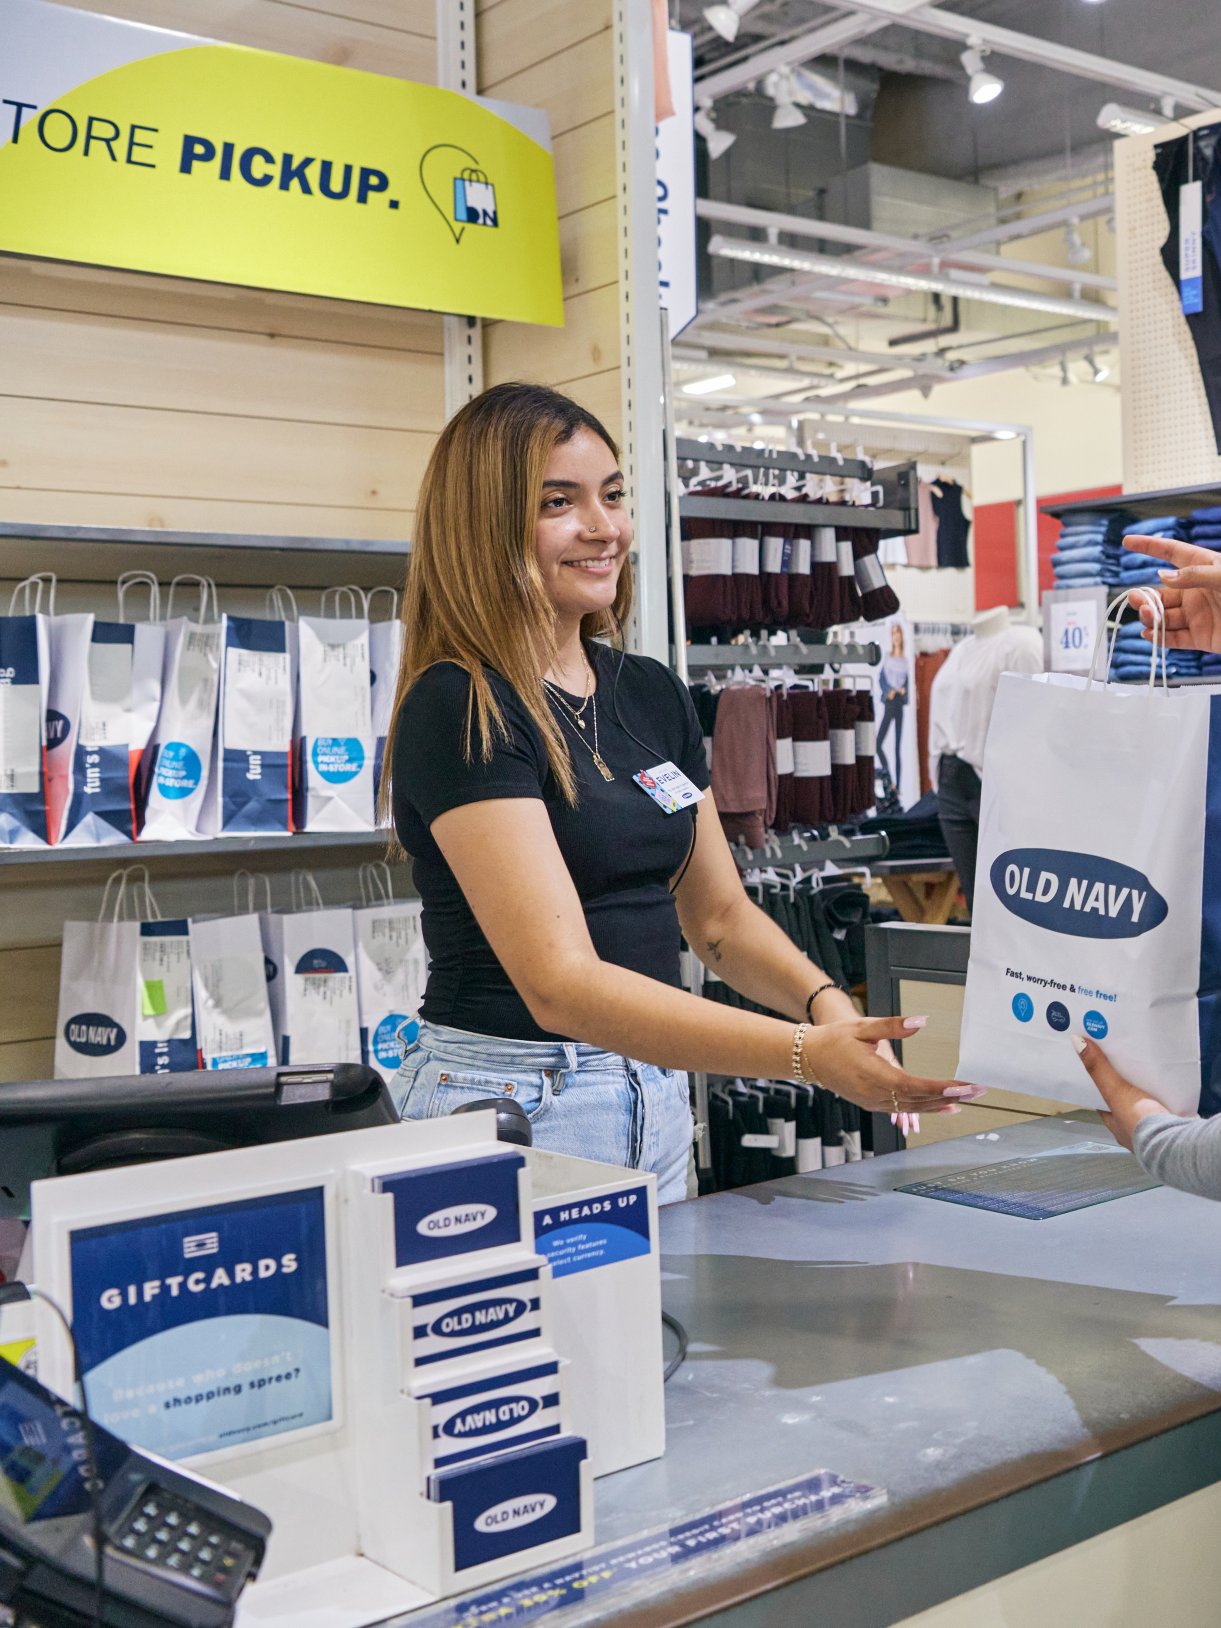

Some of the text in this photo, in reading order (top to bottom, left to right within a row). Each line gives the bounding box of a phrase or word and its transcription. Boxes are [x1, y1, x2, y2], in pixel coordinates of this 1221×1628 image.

[2, 98, 401, 210] TORE PICKUP.
[246, 750, 262, 780] fun'
[656, 769, 682, 785] EVELIN
[1004, 863, 1148, 924] OLD NAVY
[1005, 967, 1118, 1003] Fast, worry-free & free free!
[69, 1024, 118, 1046] OLD NAVY
[427, 1209, 488, 1232] OLD NAVY
[542, 1194, 638, 1227] A HEADS UP
[100, 1253, 298, 1311] GIFTCARDS
[441, 1302, 518, 1333] OLD NAVY
[164, 1382, 243, 1410] shopping
[249, 1367, 302, 1391] spree?
[453, 1400, 530, 1435] OLD NAVY
[484, 1499, 547, 1527] OLD NAVY
[623, 1544, 682, 1569] YOUR
[685, 1521, 740, 1547] FIRST
